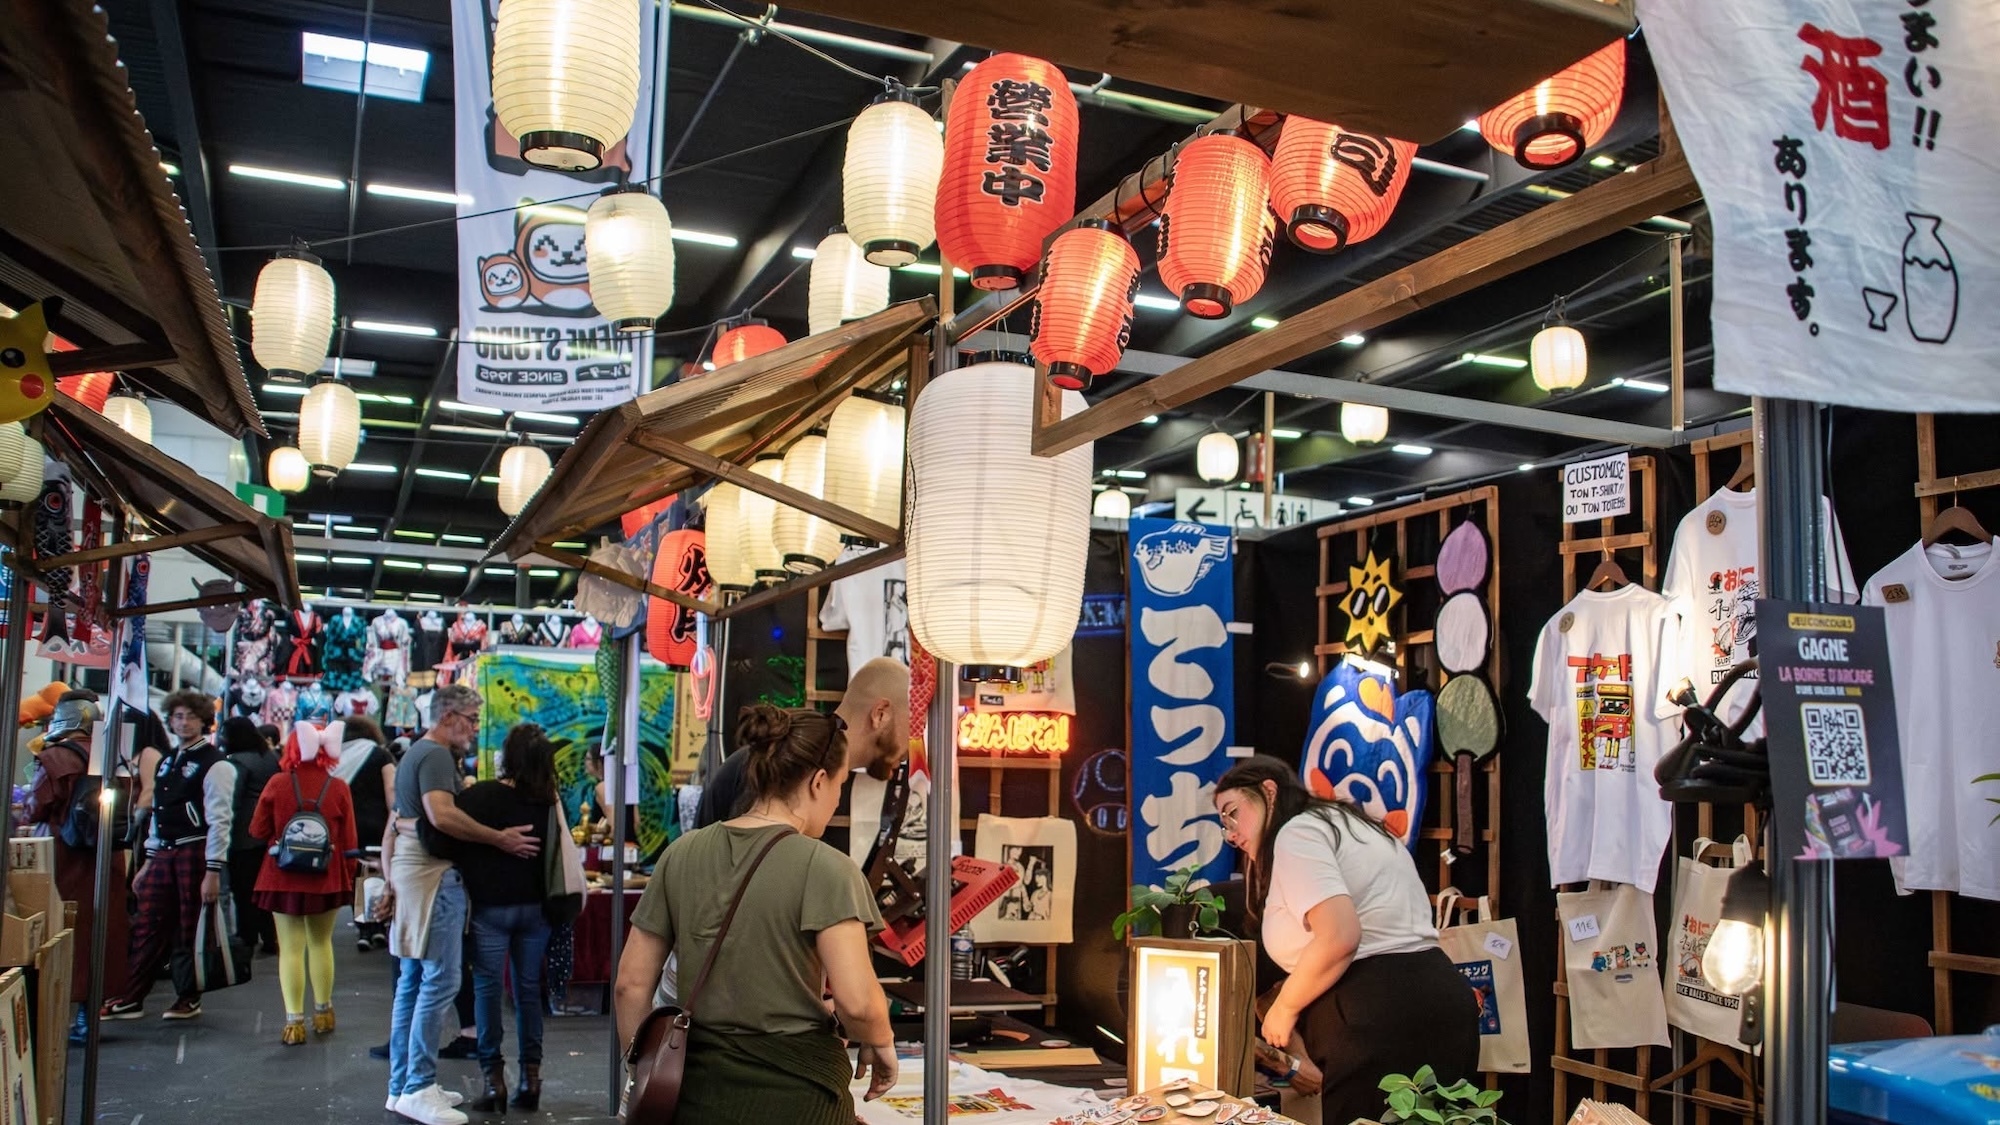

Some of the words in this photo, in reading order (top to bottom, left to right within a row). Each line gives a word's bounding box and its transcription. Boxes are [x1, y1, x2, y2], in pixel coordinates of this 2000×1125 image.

[1797, 22, 1891, 150] 酒
[1900, 0, 1942, 151] まい!!
[1772, 134, 1820, 337] あります。
[1567, 460, 1626, 485] CUSTOMISE
[1570, 488, 1589, 499] TON
[1565, 504, 1578, 516] OU
[1582, 501, 1600, 514] TON
[1797, 636, 1850, 662] GAGNE
[1778, 666, 1793, 682] LA
[1140, 603, 1228, 892] こっち
[1459, 964, 1489, 978] キング
[1707, 990, 1723, 1006] SINCE
